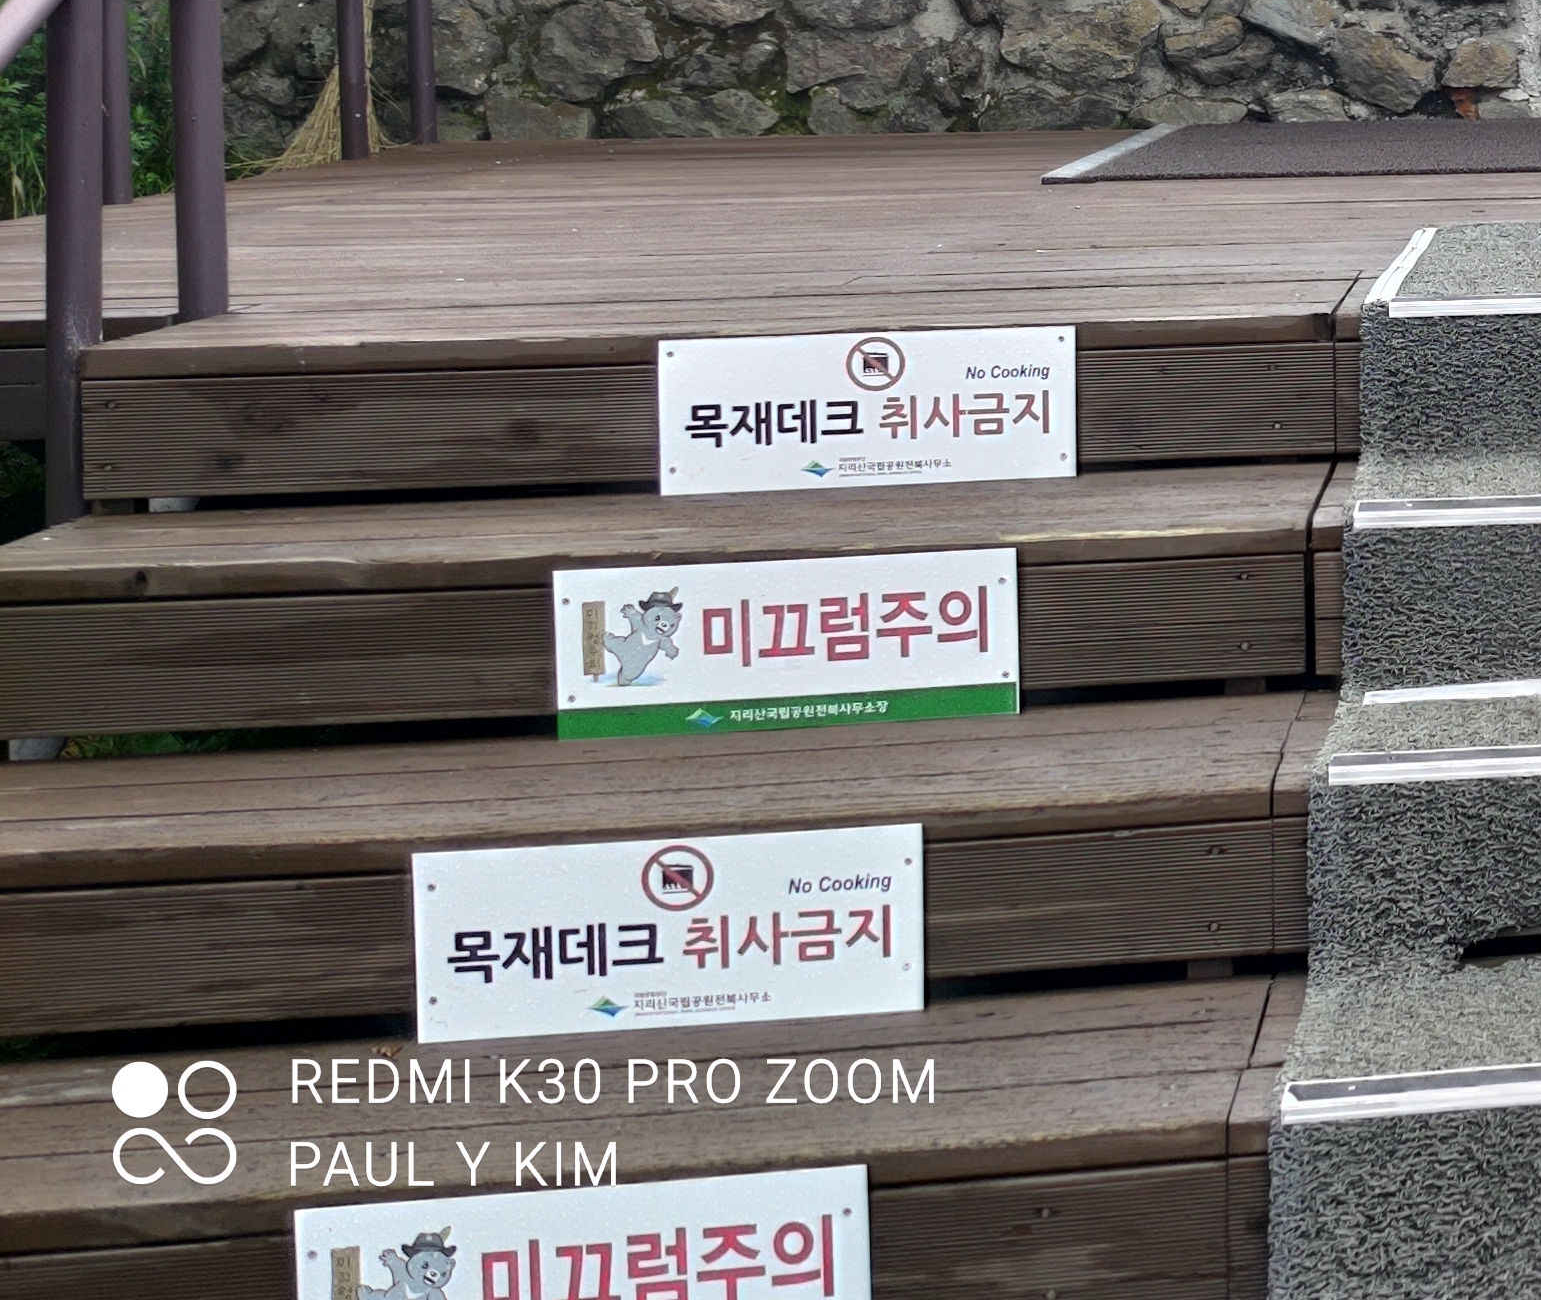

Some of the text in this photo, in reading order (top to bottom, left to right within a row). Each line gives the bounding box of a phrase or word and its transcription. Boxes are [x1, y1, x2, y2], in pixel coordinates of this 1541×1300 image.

[966, 362, 1050, 382] No Cooking
[684, 390, 1051, 449] 목재데크 취사금지
[701, 585, 989, 668] 미끄럼주의
[730, 700, 889, 722] 지리산국립공원전북사무소장
[788, 870, 893, 897] No Cooking
[447, 905, 894, 985] 목재데크 취사금지
